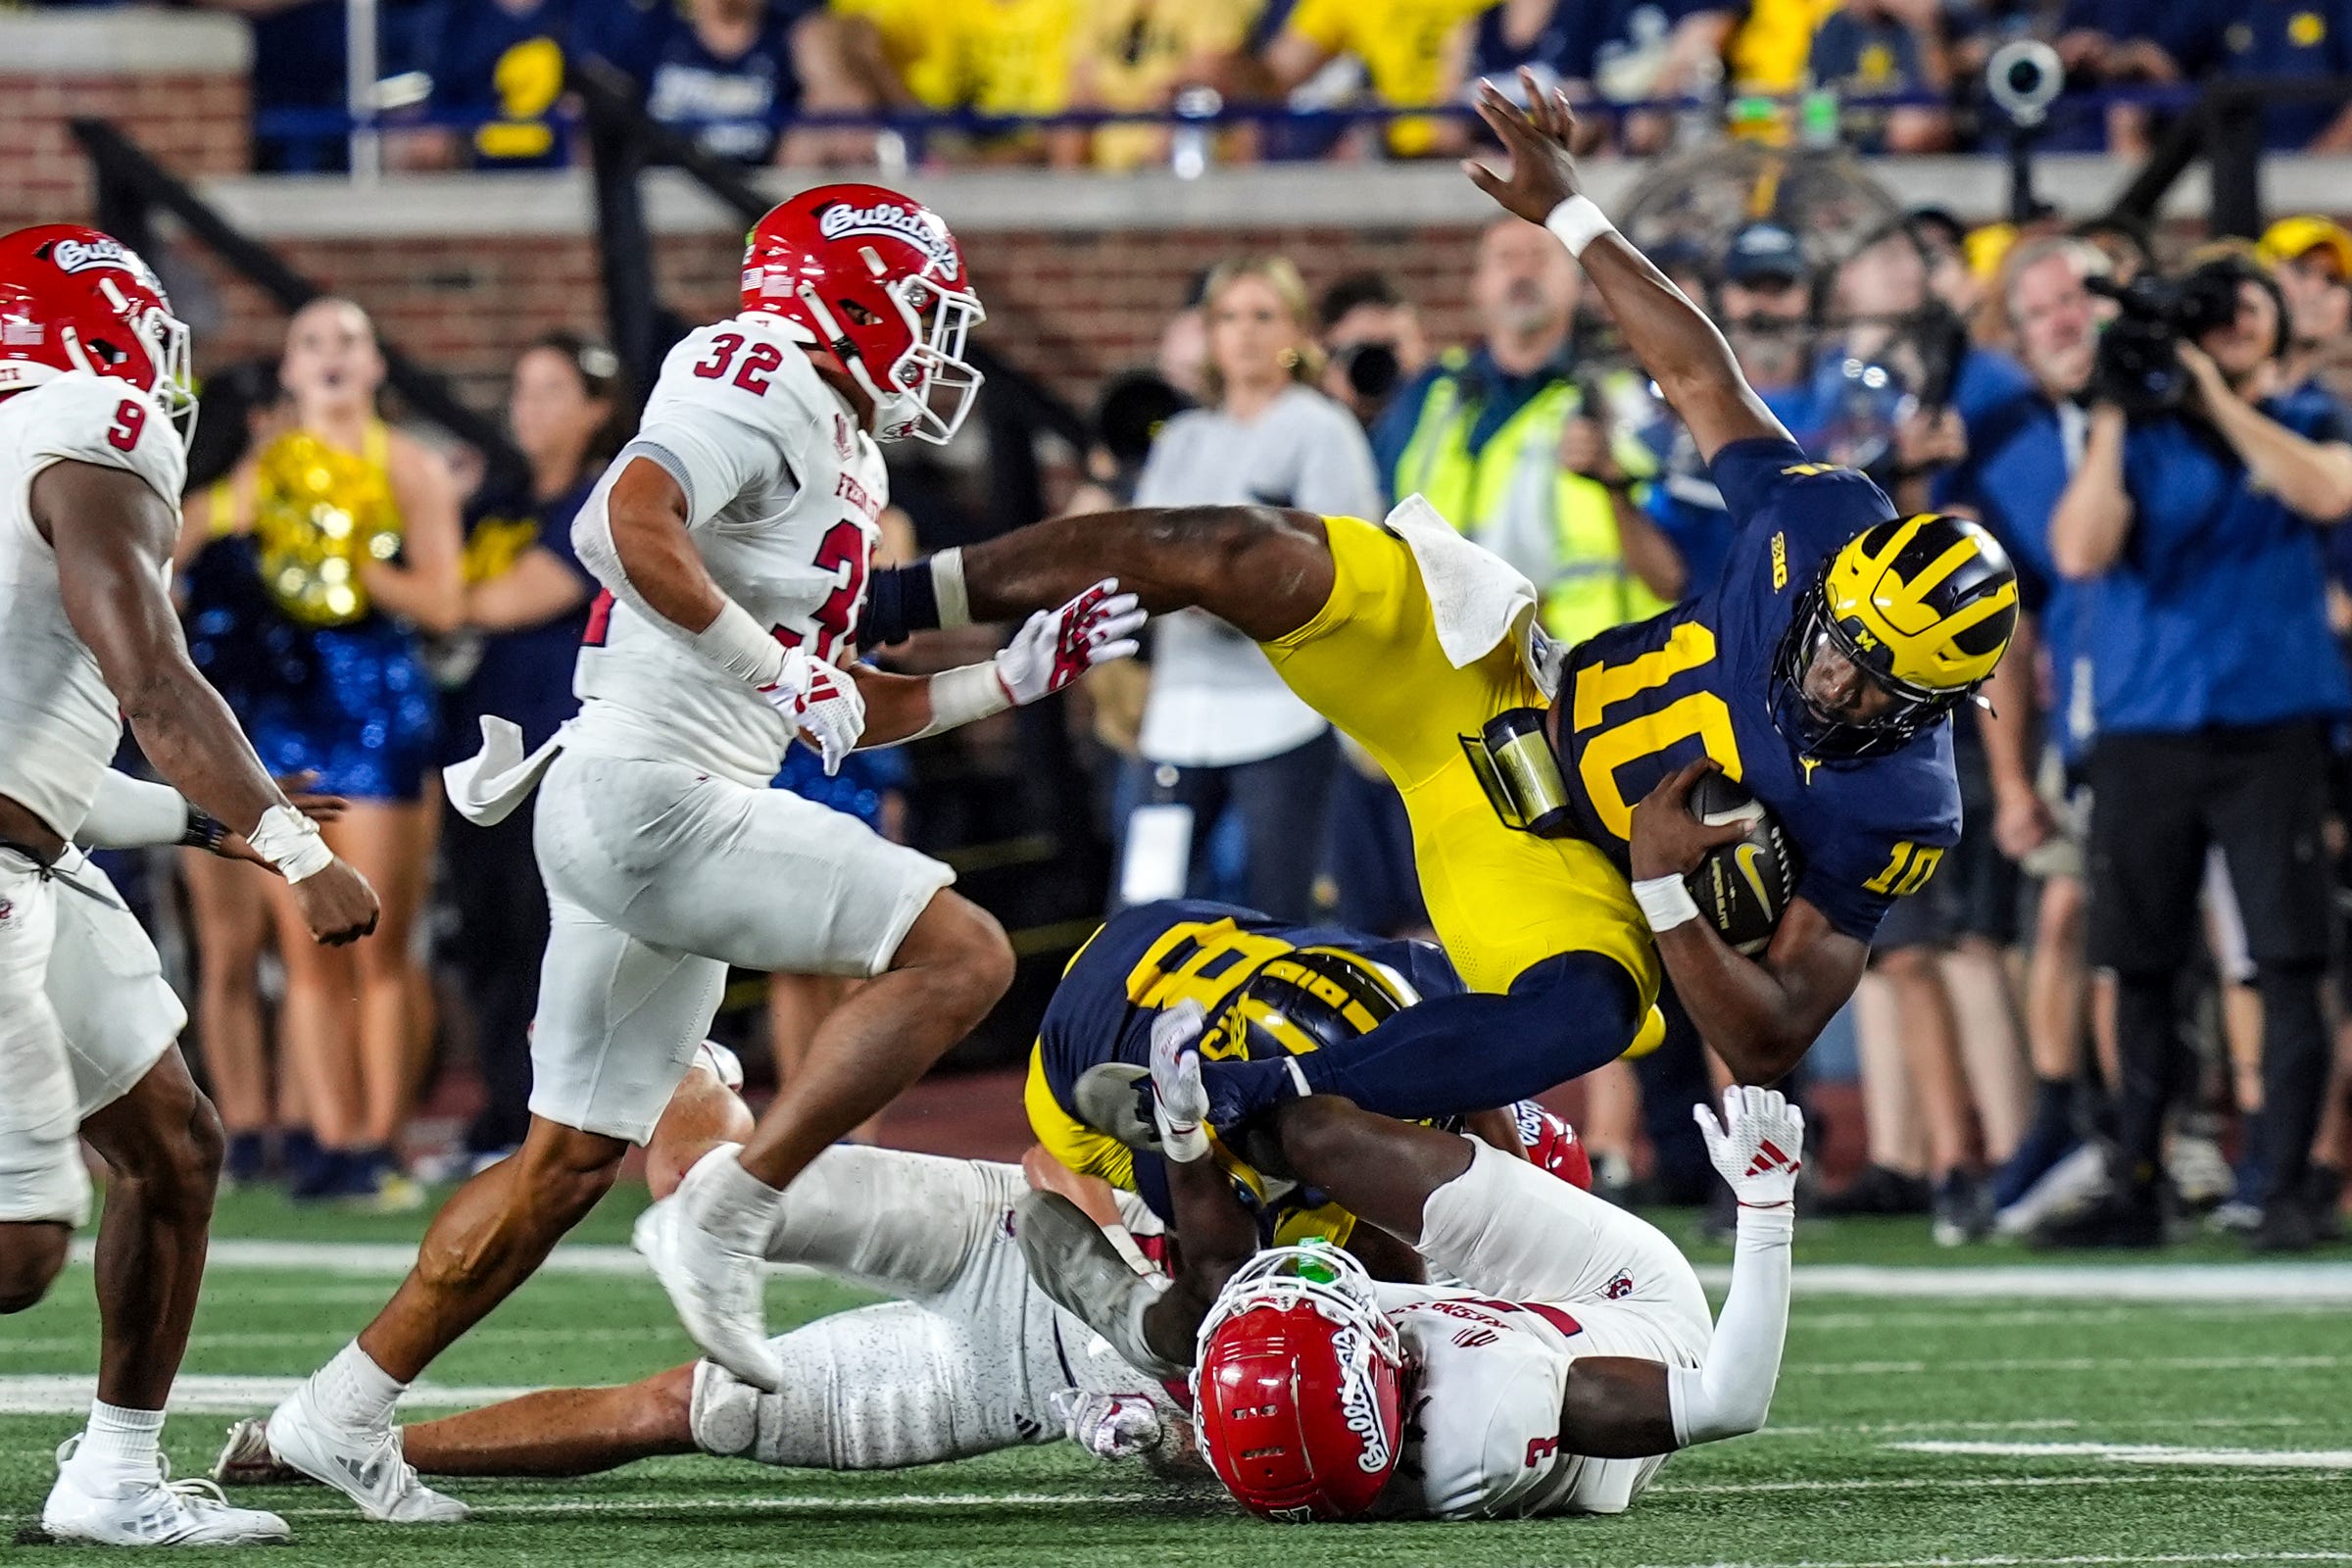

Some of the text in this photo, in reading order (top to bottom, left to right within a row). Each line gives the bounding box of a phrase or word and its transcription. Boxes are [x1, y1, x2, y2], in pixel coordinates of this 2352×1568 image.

[693, 333, 783, 397] 32
[109, 399, 145, 452] 9
[1573, 620, 1743, 843] 10
[1861, 841, 1944, 896] 10
